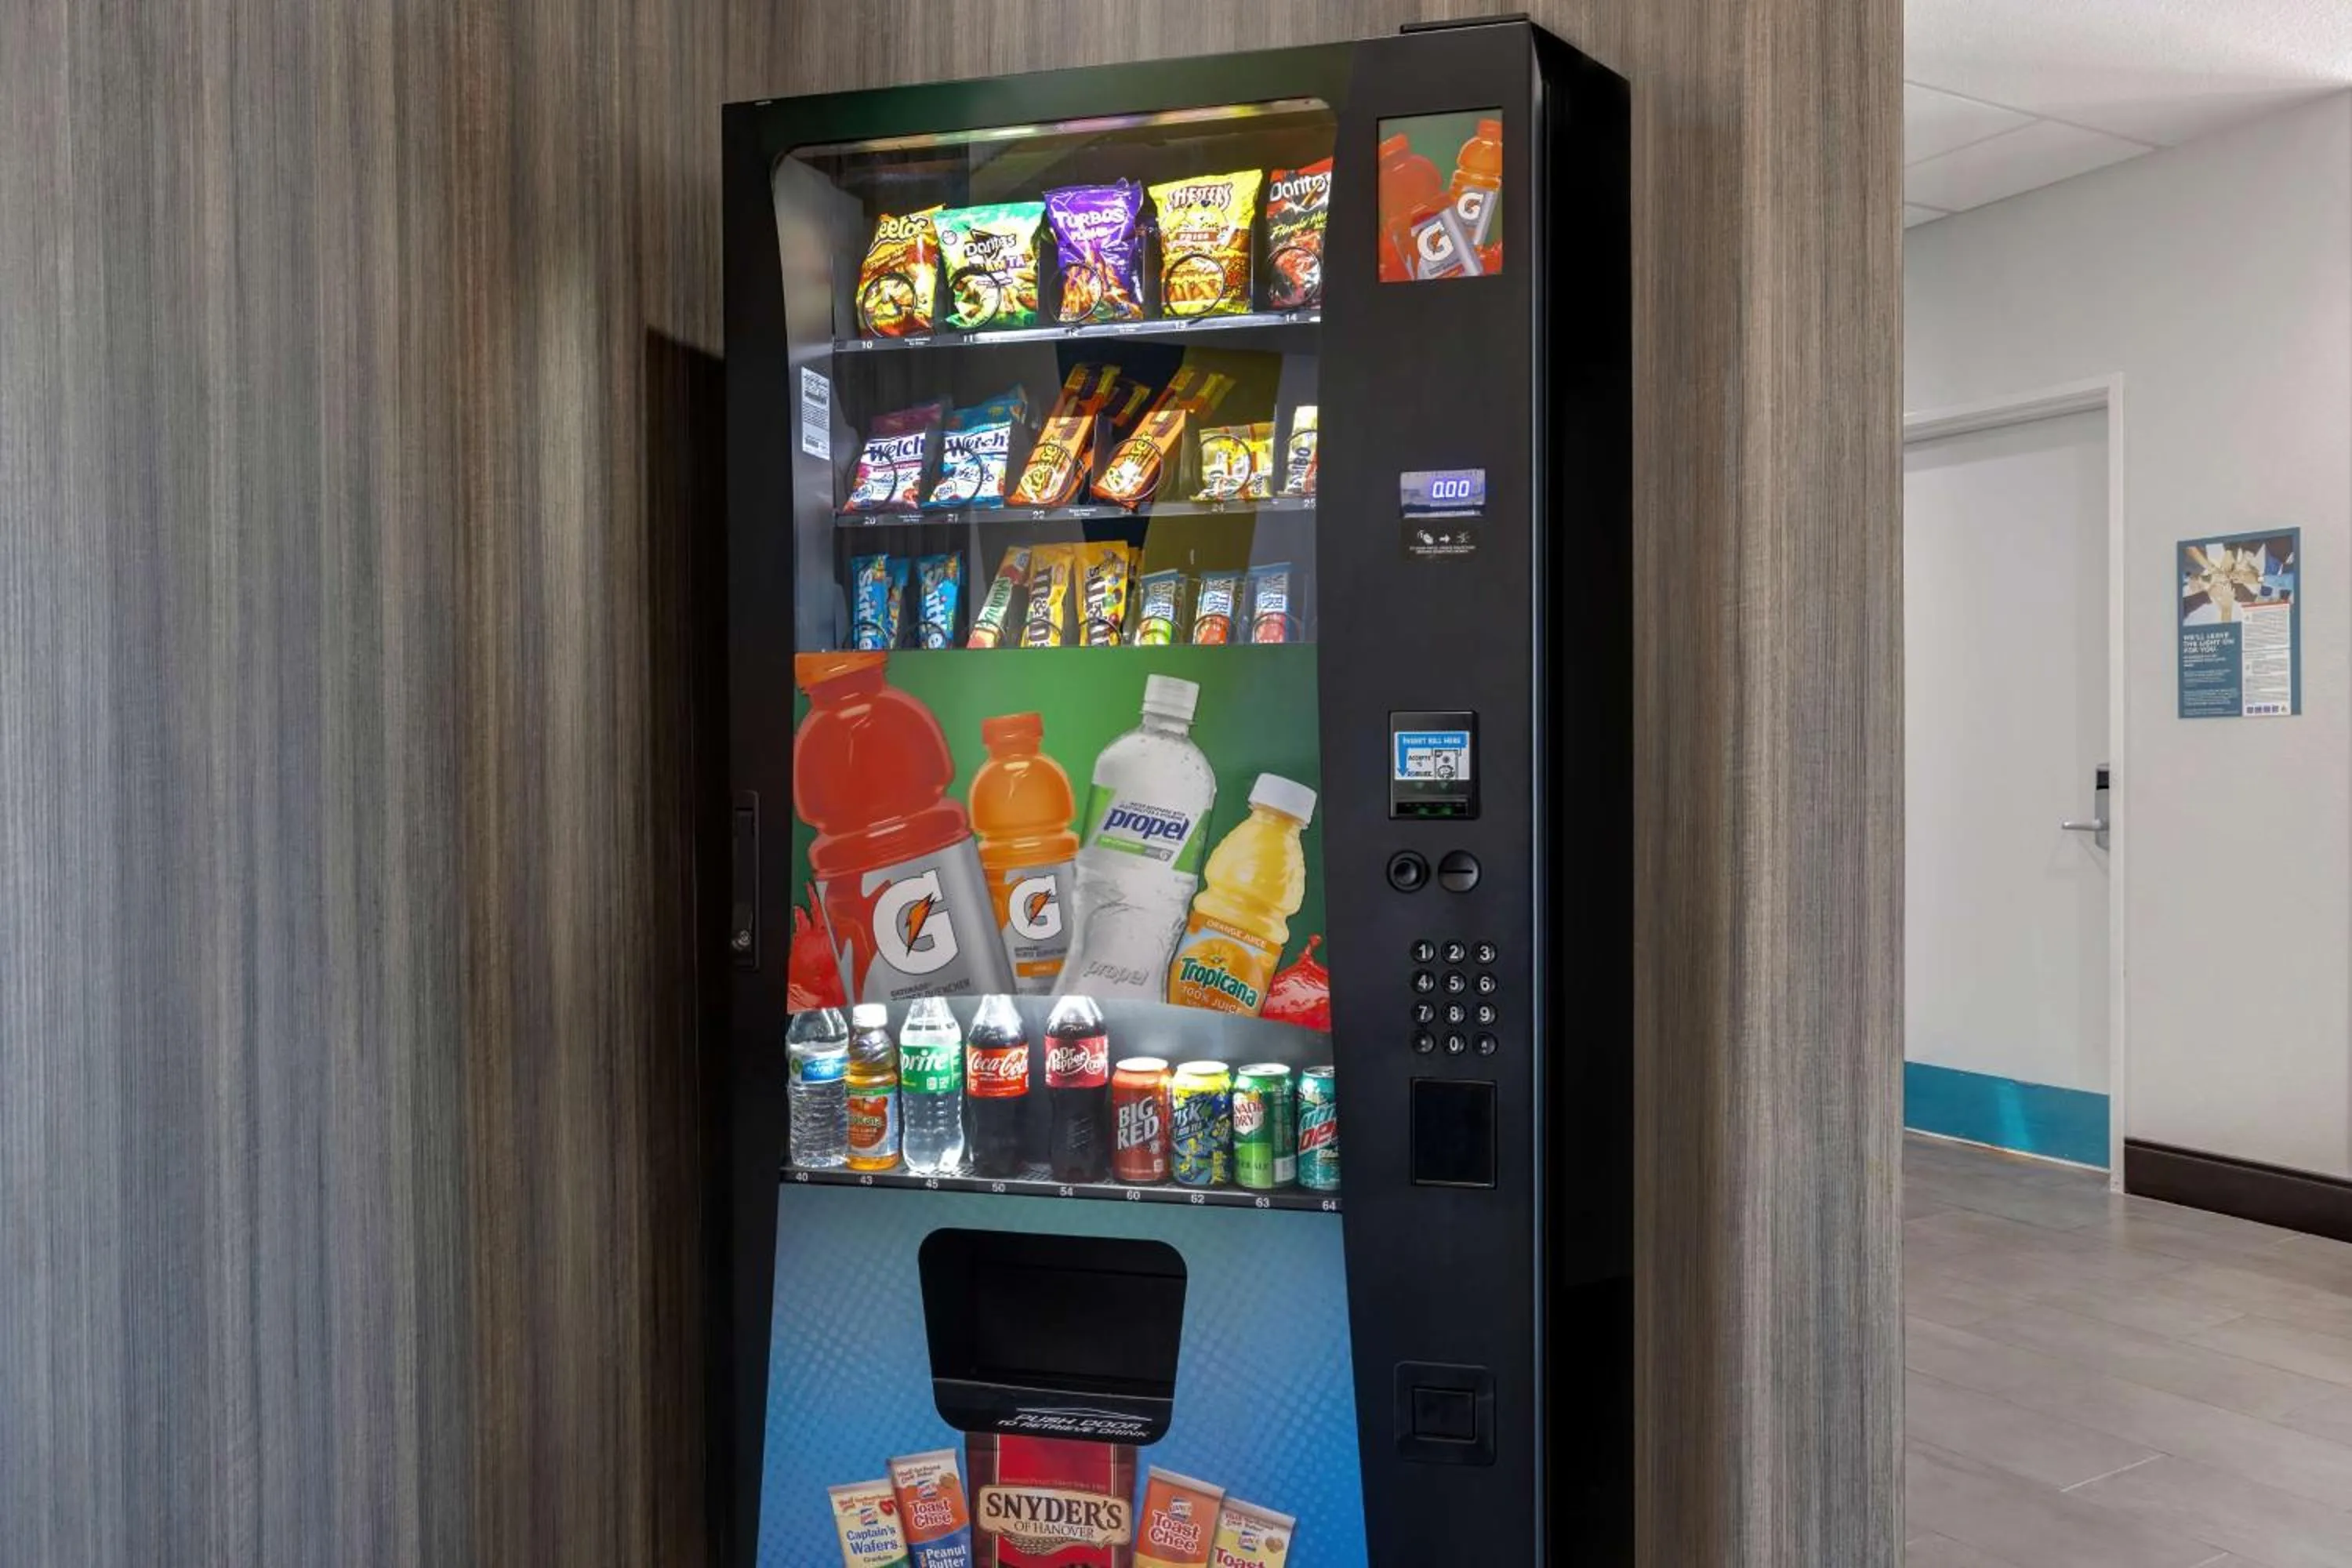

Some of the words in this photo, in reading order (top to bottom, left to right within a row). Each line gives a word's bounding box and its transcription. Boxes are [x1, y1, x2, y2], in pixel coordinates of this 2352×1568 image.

[1457, 192, 1483, 220] G
[879, 214, 928, 239] eetos
[1053, 208, 1127, 229] TURBOS
[964, 234, 1017, 257] Doritos
[1417, 220, 1454, 261] G
[869, 436, 925, 462] Welch
[947, 430, 1008, 457] Welch'
[858, 568, 878, 649] Skittle
[924, 566, 948, 649] Skittle
[1103, 808, 1190, 840] propel
[1009, 875, 1063, 940] G
[873, 868, 959, 975] G
[1419, 945, 1426, 959] 1
[1450, 946, 1458, 959] 2
[1480, 946, 1490, 960] 3
[1179, 956, 1258, 1008] Tropicana
[1418, 975, 1427, 989] 4
[1450, 977, 1458, 990] 5
[1480, 977, 1490, 991] 6
[1419, 1005, 1427, 1020] 7
[1450, 1007, 1458, 1021] 8
[1480, 1007, 1490, 1022] 9
[1450, 1036, 1458, 1051] 0
[902, 1049, 945, 1073] prite
[1119, 1096, 1154, 1128] BIG
[1174, 1102, 1202, 1127] ISK
[1117, 1116, 1160, 1150] RED
[796, 1172, 808, 1181] 40
[861, 1175, 873, 1185] 43
[926, 1178, 938, 1189] 45
[992, 1182, 1005, 1192] 50
[1256, 1197, 1270, 1208] 63
[1322, 1200, 1336, 1211] 64
[1014, 1414, 1076, 1425] PUSH
[1080, 1419, 1142, 1430] DOOR
[910, 1498, 950, 1514] Toast
[985, 1492, 1123, 1531] SNYDER'S
[913, 1513, 953, 1528] Chee
[1014, 1519, 1033, 1532] OF
[1034, 1522, 1094, 1538] HANOVER
[1152, 1511, 1200, 1541] Toast
[846, 1526, 897, 1541] Captain's
[1149, 1527, 1196, 1552] Chee
[850, 1538, 898, 1555] Wafers
[926, 1544, 967, 1559] Peanut
